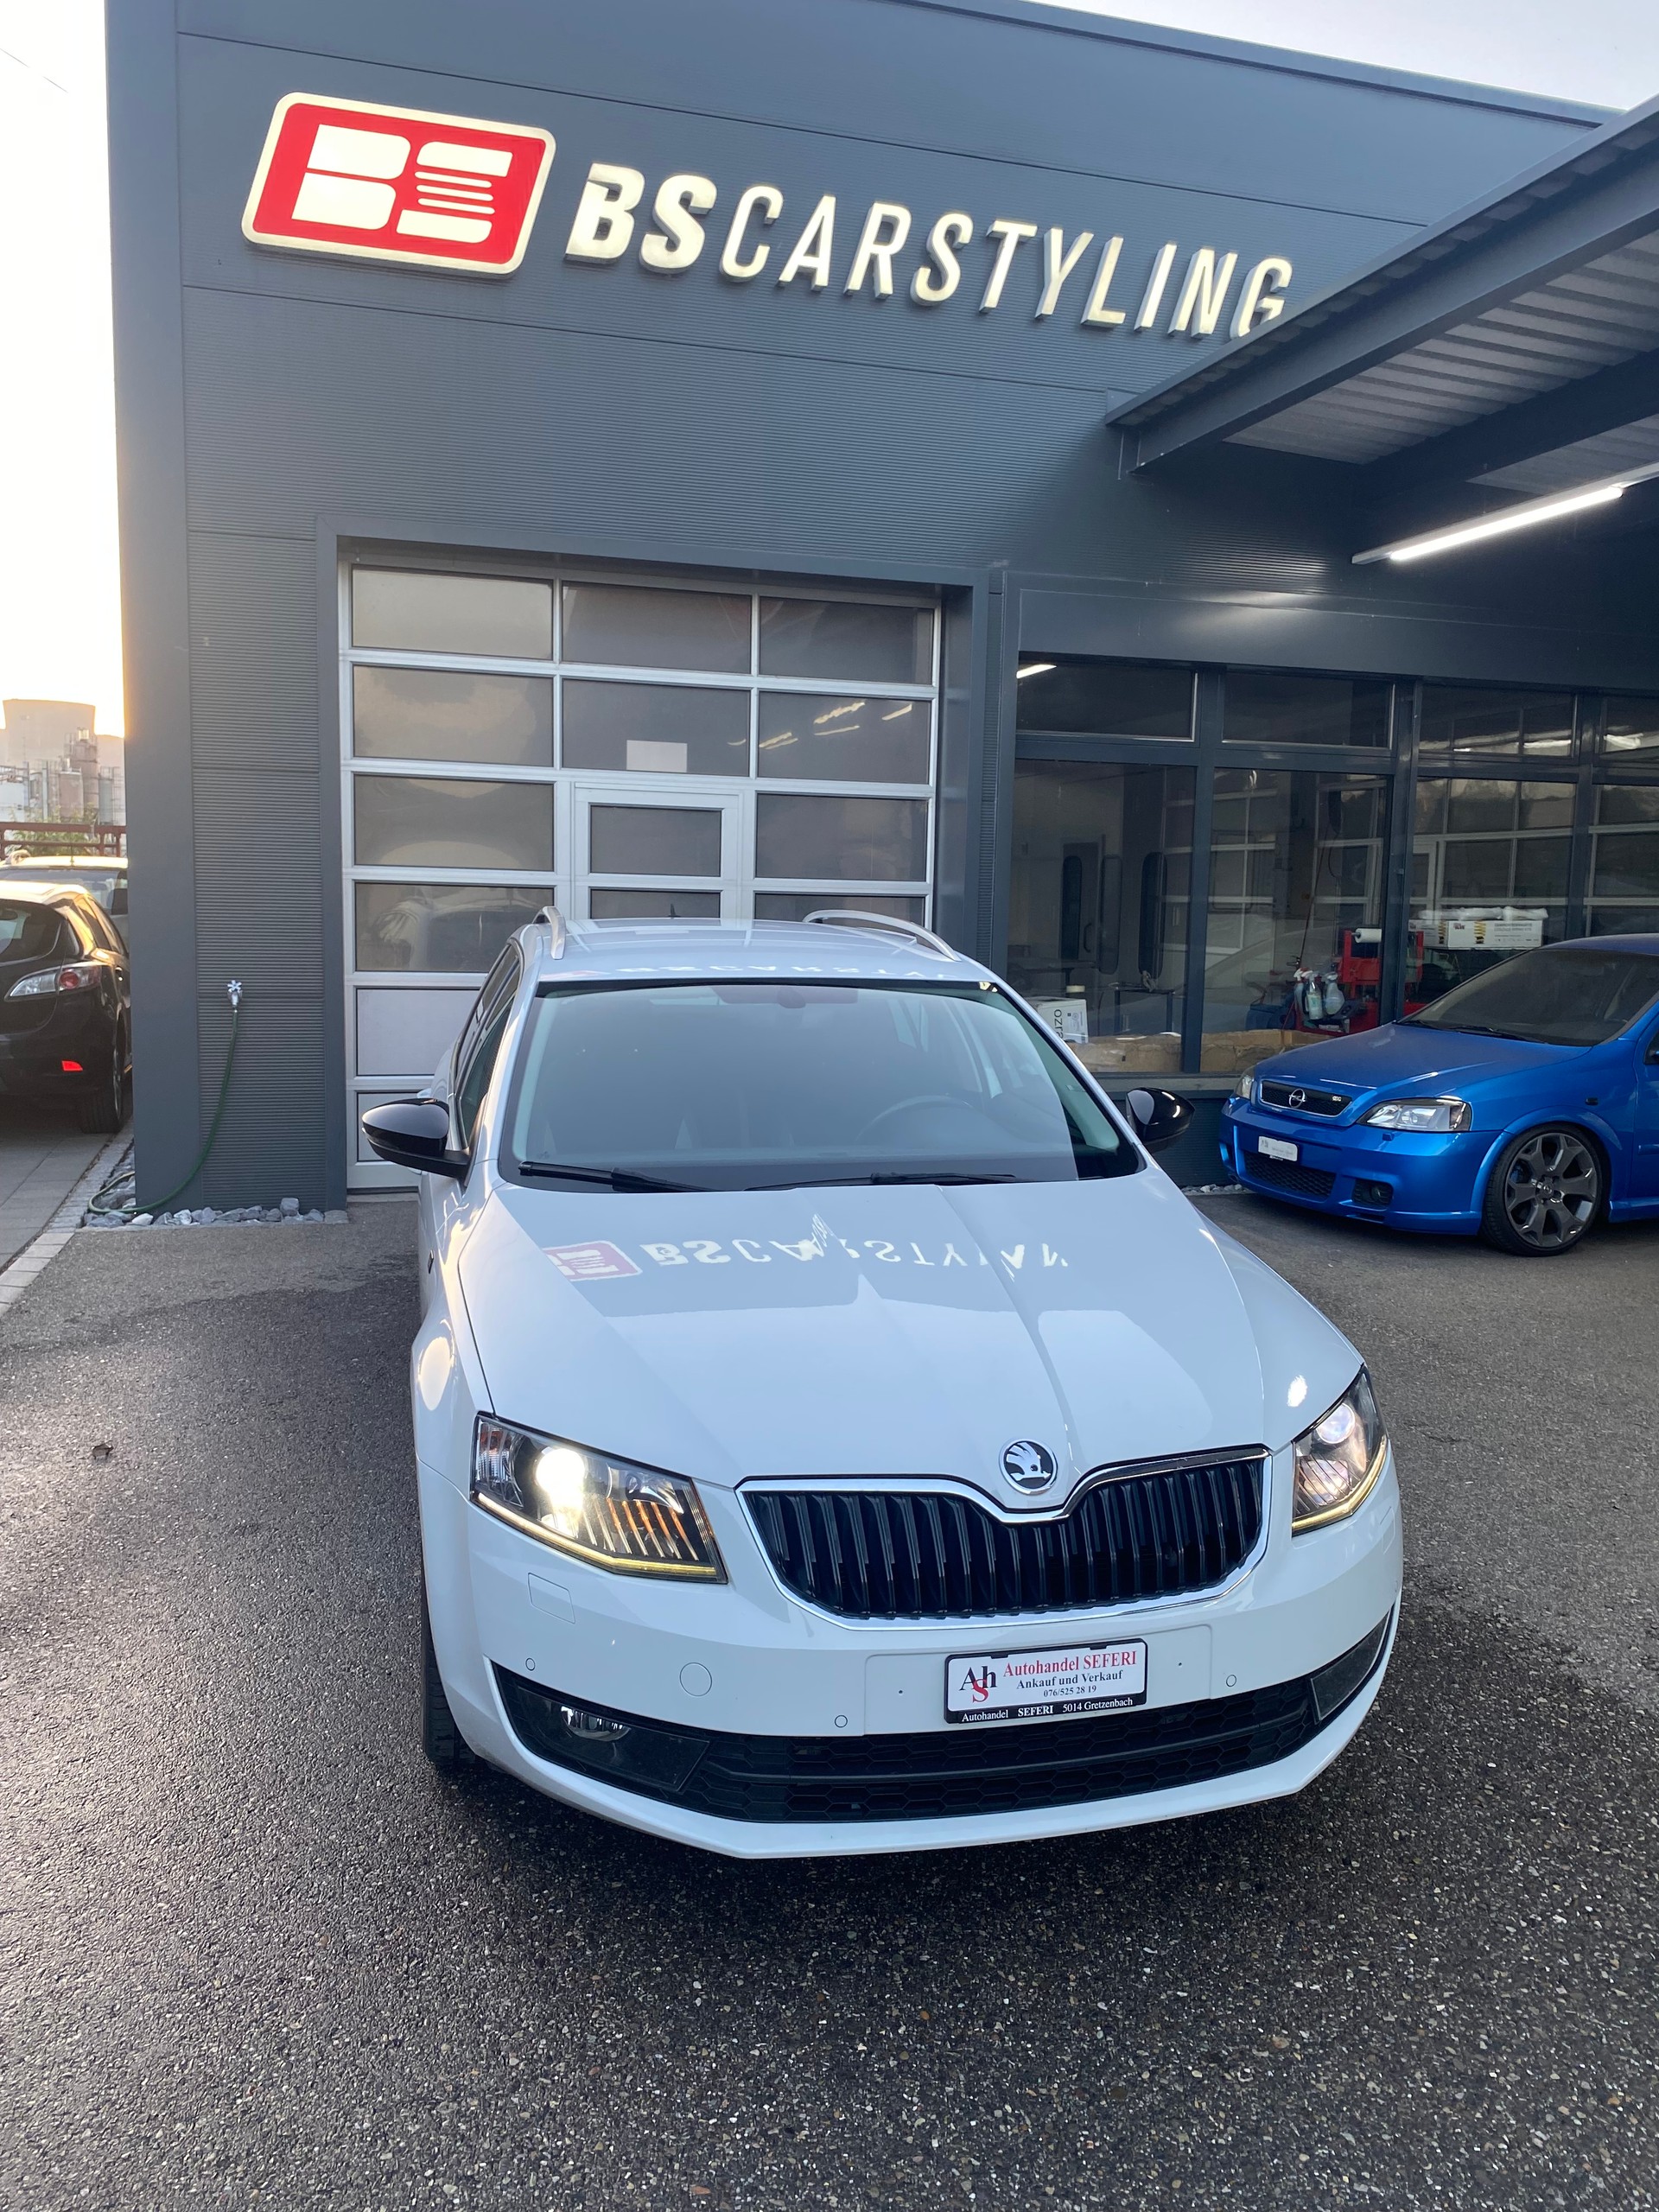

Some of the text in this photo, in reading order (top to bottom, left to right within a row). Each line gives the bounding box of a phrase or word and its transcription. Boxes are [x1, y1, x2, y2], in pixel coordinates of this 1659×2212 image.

[1003, 1650, 1136, 1676] Autohandel SEFERI
[1016, 1669, 1123, 1689] Ankauf und Verkauf
[1043, 1685, 1096, 1698] 076/525 28 19
[962, 1697, 1134, 1723] Autohandel SEFERI 5014 Gretzenbach
